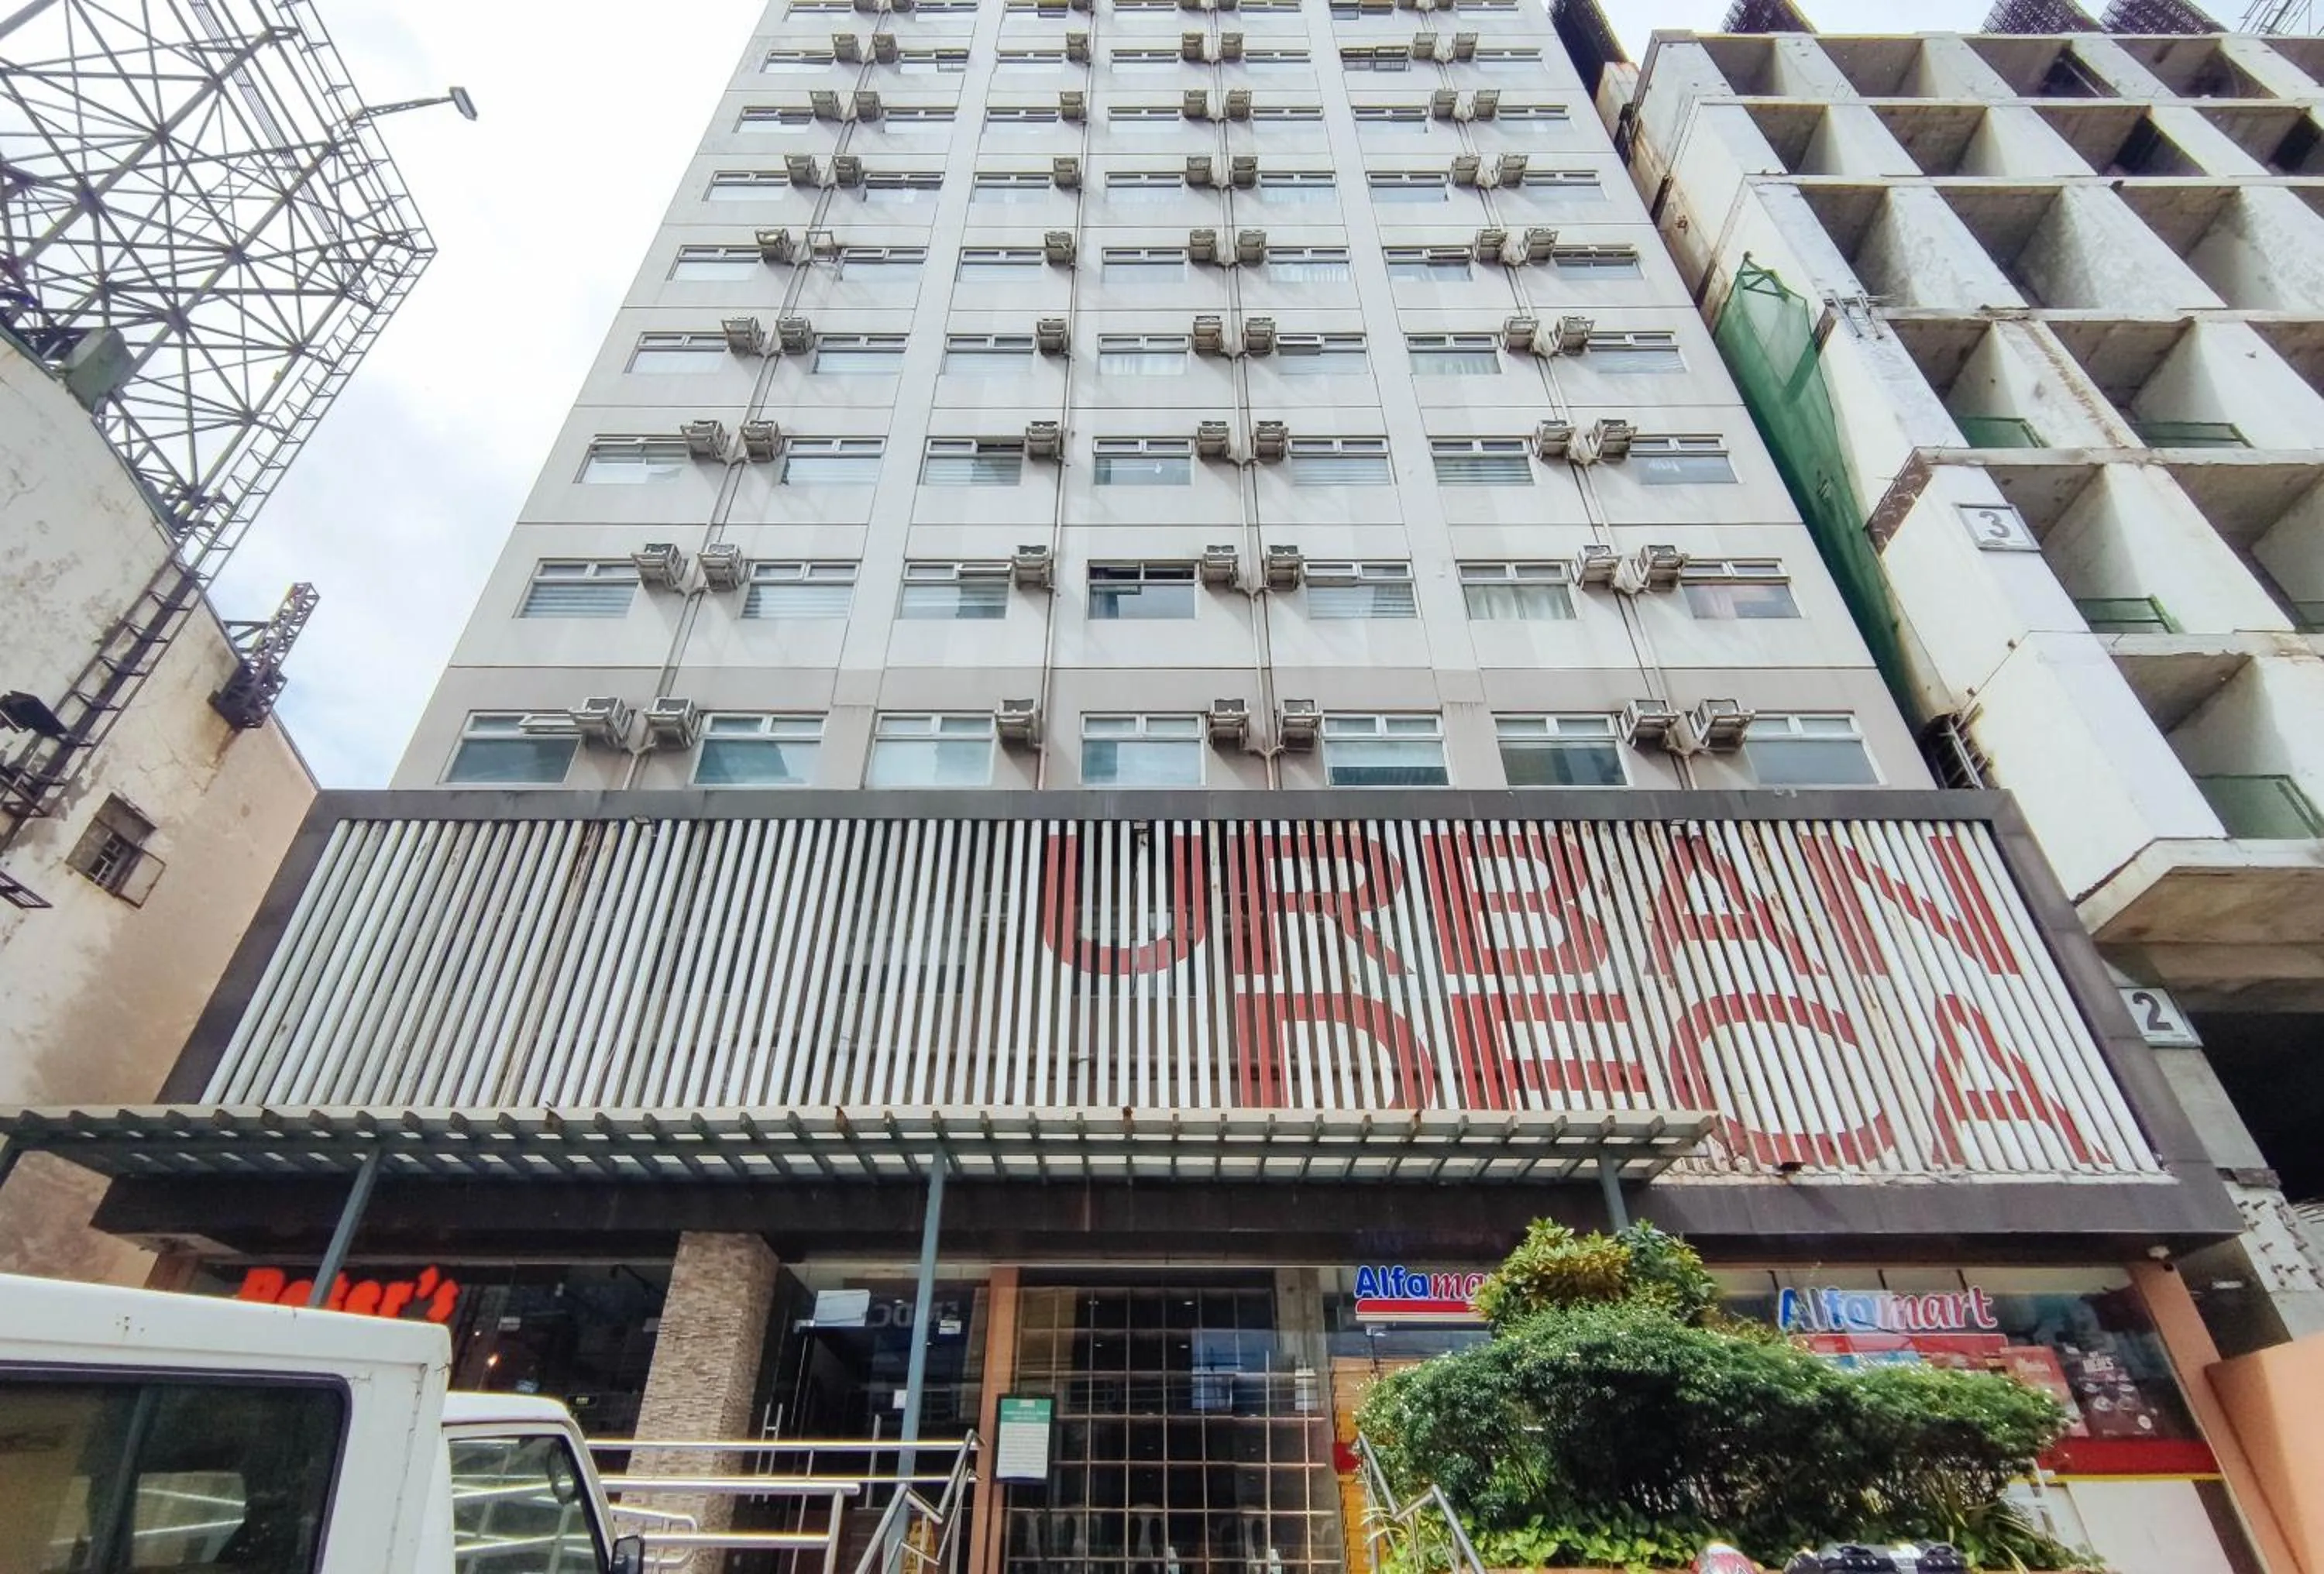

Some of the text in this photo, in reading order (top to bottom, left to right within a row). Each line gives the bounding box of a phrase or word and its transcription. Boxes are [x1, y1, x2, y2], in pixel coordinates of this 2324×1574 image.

[1978, 510, 2011, 538] 3
[1044, 833, 2022, 975] URBAN
[2132, 991, 2174, 1031] 2
[1236, 992, 2113, 1165] DECA
[1354, 1265, 1487, 1300] Alfama
[1778, 1284, 1999, 1332] Alfamart
